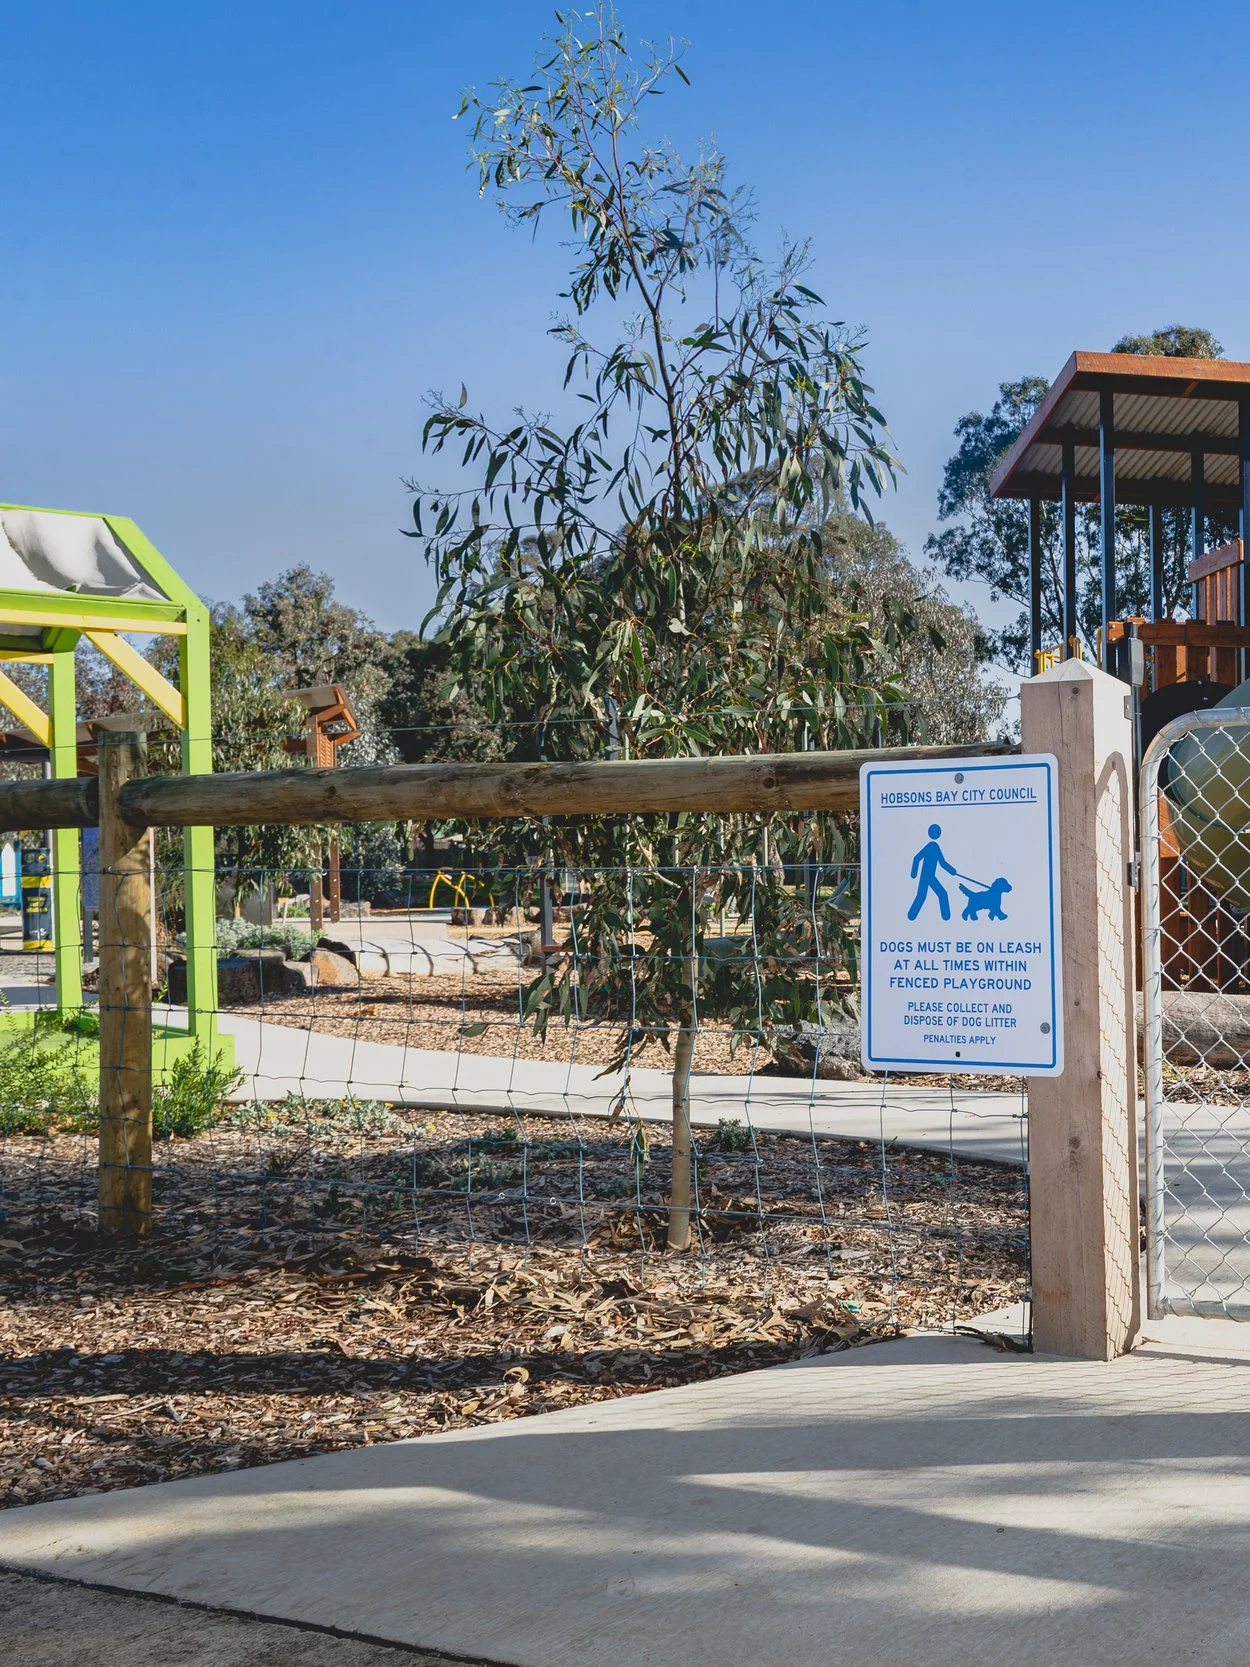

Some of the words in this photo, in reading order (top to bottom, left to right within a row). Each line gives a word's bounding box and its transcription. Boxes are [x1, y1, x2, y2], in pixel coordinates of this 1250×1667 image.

[881, 792, 932, 805] HOBSONS
[937, 791, 958, 802] BAY
[962, 790, 985, 802] CITY
[989, 788, 1037, 800] COUNCIL
[880, 942, 913, 952] DOGS
[918, 942, 951, 952] MUST
[956, 942, 971, 953] BE
[977, 942, 994, 953] ON
[999, 942, 1042, 953] LEASH
[894, 960, 910, 970] AT
[914, 960, 938, 970] ALL
[943, 960, 979, 971] TIMES
[984, 960, 1027, 971] WITHIN
[890, 977, 938, 988] FENCED
[944, 978, 1031, 990] PLAYGROUND
[908, 1002, 943, 1012] PLEASE
[947, 1003, 989, 1013] COLLECT
[992, 1004, 1012, 1013] AND
[904, 1016, 943, 1026] DISPOSE
[947, 1017, 958, 1026] OF
[962, 1017, 981, 1027] DOG
[985, 1018, 1016, 1027] LITTER
[924, 1035, 966, 1043] PENALTIES
[969, 1036, 996, 1044] APPLY
